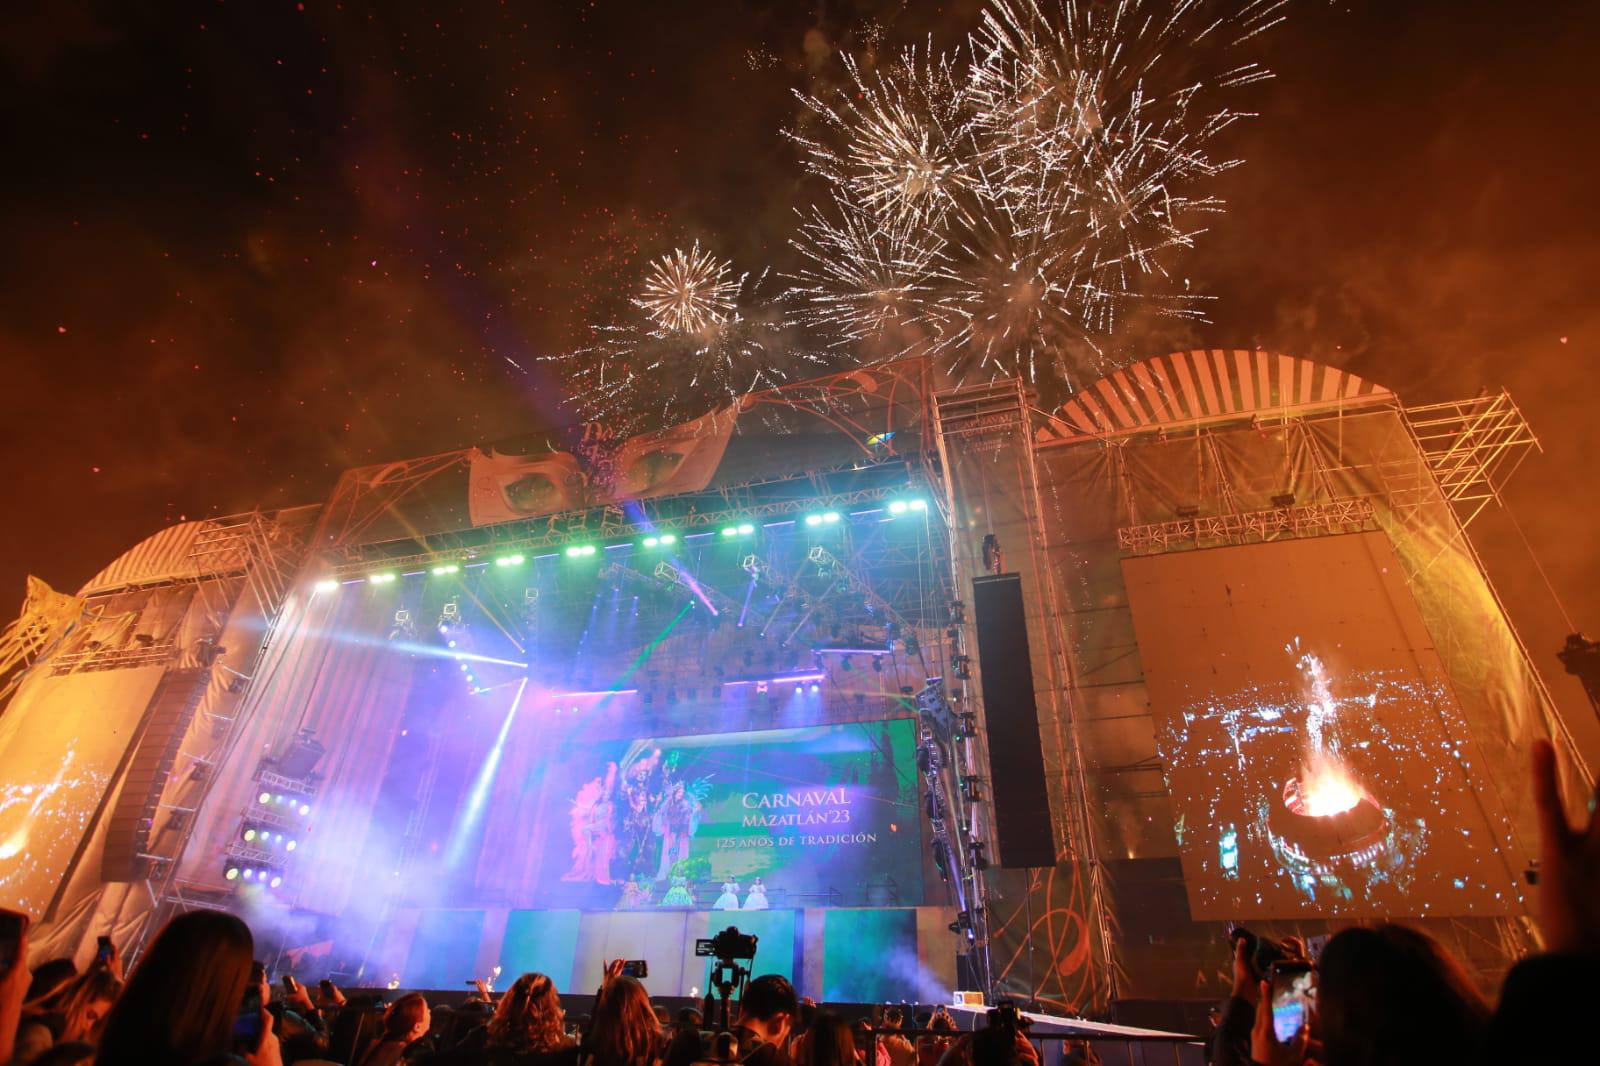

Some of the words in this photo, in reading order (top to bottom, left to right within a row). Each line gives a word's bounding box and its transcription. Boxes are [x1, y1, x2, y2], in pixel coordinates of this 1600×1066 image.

[742, 788, 851, 809] CARNAVAL
[717, 837, 736, 849] 125
[778, 836, 795, 847] DE
[800, 832, 877, 846] TRADICIÓN
